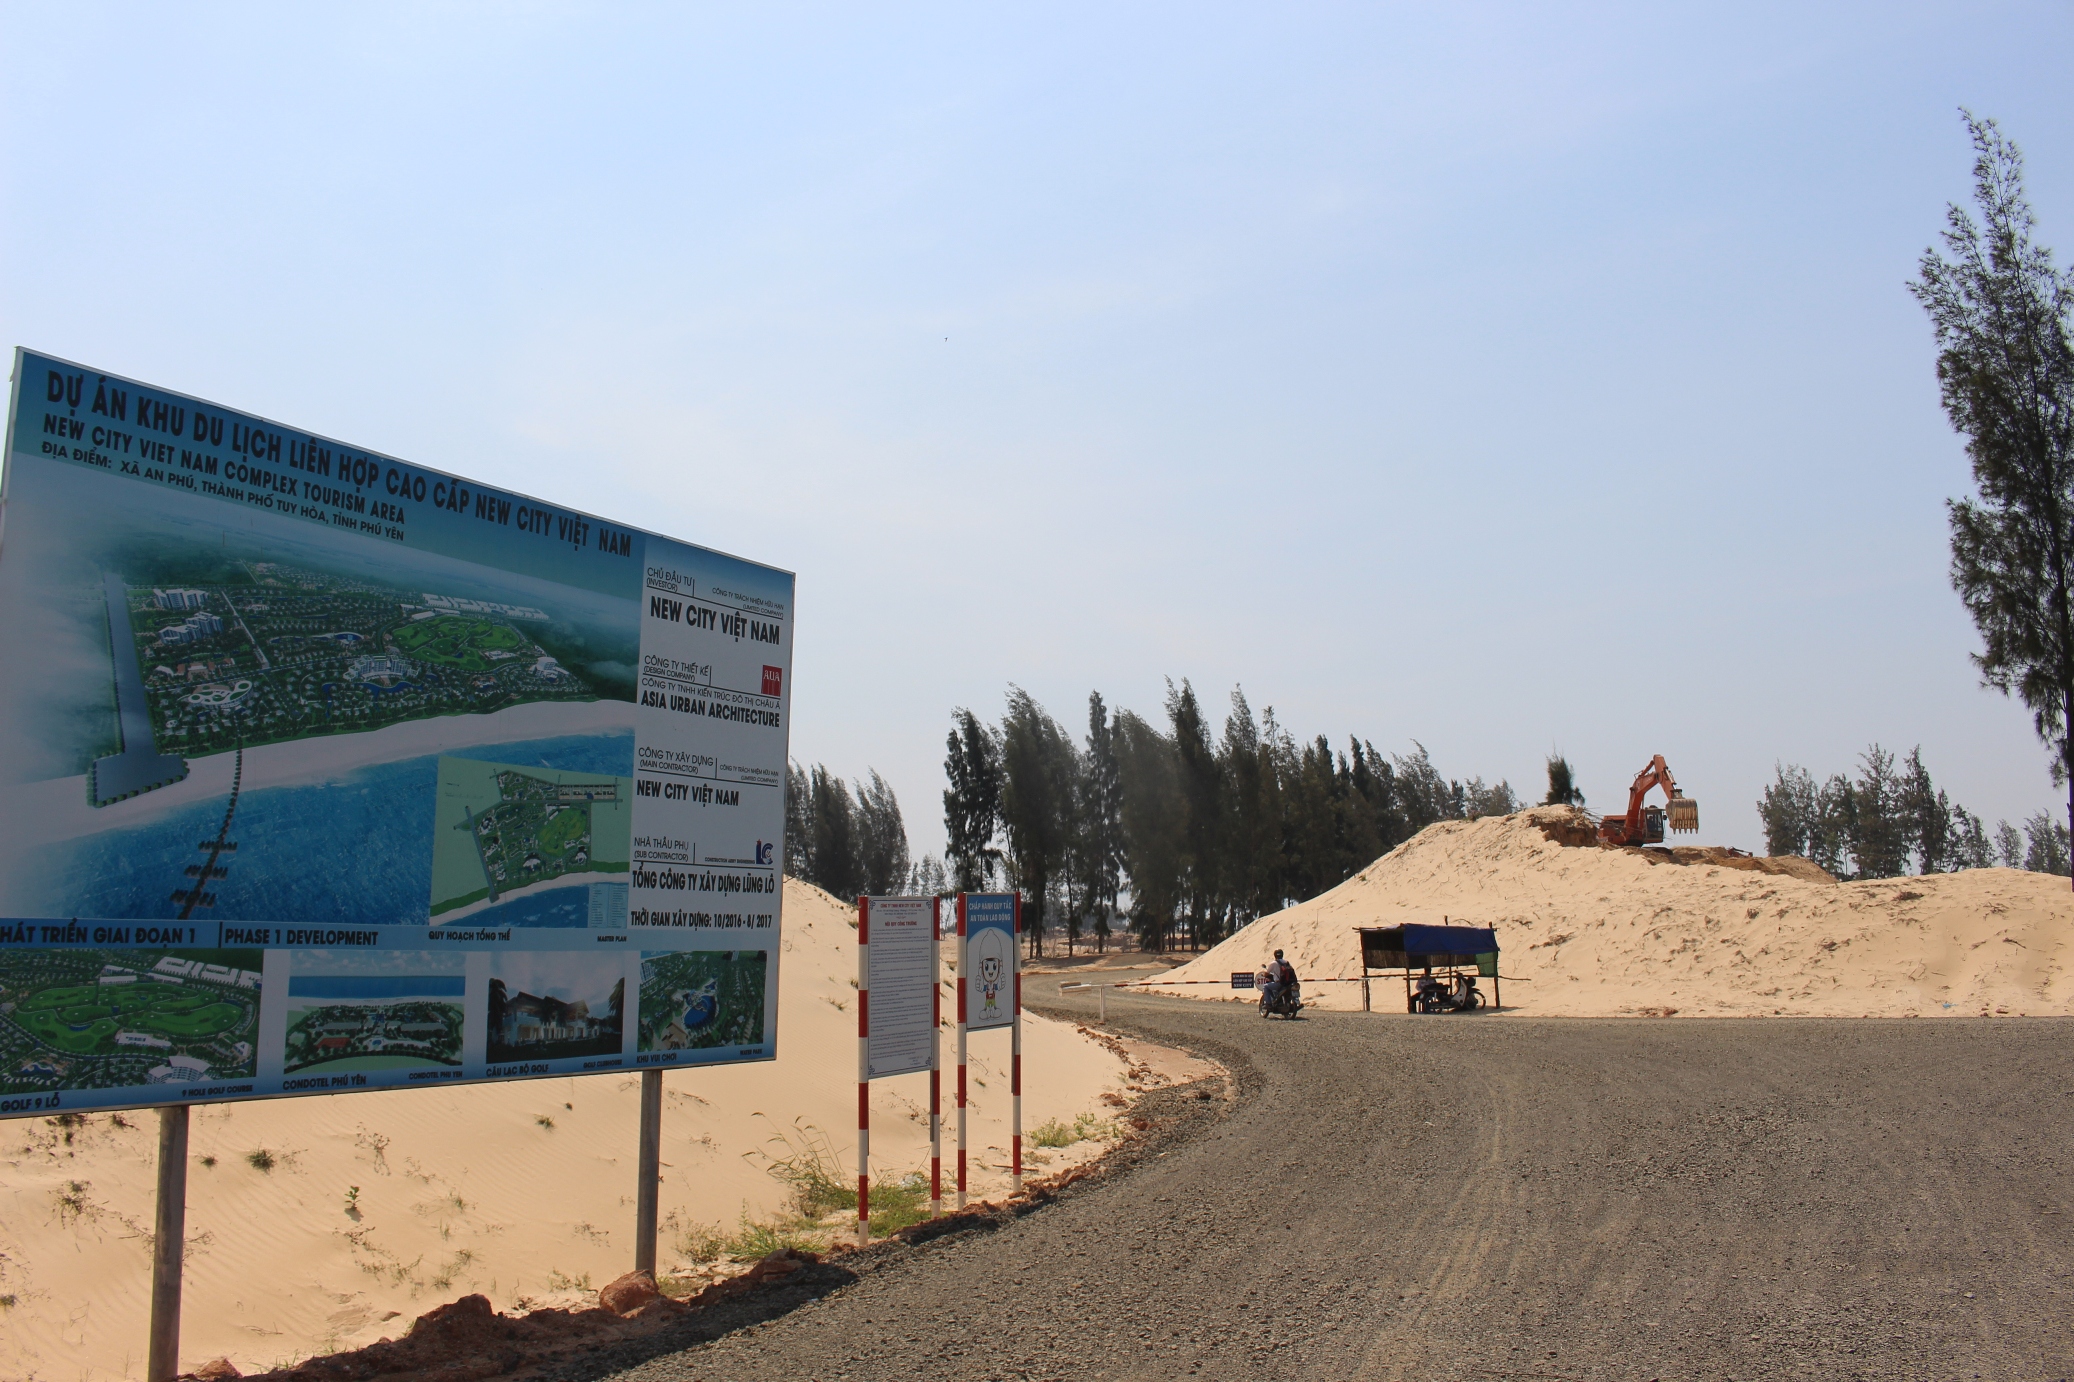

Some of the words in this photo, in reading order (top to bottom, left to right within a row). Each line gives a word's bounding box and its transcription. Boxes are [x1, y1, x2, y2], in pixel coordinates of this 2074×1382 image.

[43, 413, 85, 441] NEW
[92, 426, 132, 453] CITY
[139, 438, 175, 465] VIET
[181, 449, 218, 475] NAM
[224, 461, 298, 496] COMPLEX
[303, 482, 365, 514] TOURISM
[370, 500, 405, 524] AREA
[47, 370, 84, 417] DỰ
[91, 375, 127, 421] ÁN
[137, 396, 184, 437] KHU
[193, 412, 223, 446] DU
[232, 423, 281, 463] LỊCH
[290, 437, 330, 477] LIÊN
[339, 454, 379, 493] HỢP
[386, 467, 426, 502] CAO
[433, 479, 469, 514] CẤP
[475, 494, 511, 525] NEW
[517, 506, 552, 536] CITY
[559, 514, 589, 551] VIỆT
[599, 528, 631, 558] NAM
[42, 441, 67, 459] ĐỊA
[73, 447, 112, 469] ĐIỂM:
[120, 460, 140, 476] XÃ
[144, 467, 164, 481] AN
[168, 474, 198, 492] PHÚ,
[202, 481, 244, 500] THÀNH
[247, 492, 273, 509] PHỐ
[277, 499, 297, 514] TUY
[300, 506, 329, 525] HÒA,
[333, 512, 357, 529] TỈNH
[360, 522, 382, 535] PHÚ
[385, 526, 404, 541] YÊN
[647, 567, 664, 579] CHỦ
[665, 570, 682, 584] ĐẦU
[683, 576, 693, 586] TƯ
[647, 577, 678, 593] (INVESTOR)
[650, 595, 682, 623] NEW
[686, 604, 717, 631] CITY
[720, 611, 747, 642] VIỆT
[751, 620, 780, 645] NAM
[643, 666, 666, 676] (DESIGN
[666, 670, 696, 682] COMPANY)
[644, 655, 669, 668] CÔNG
[671, 660, 680, 671] TY
[681, 662, 699, 675] THIẾT
[700, 664, 709, 677] KẾ
[641, 678, 666, 689] CÔNG
[668, 681, 677, 690] TY
[677, 684, 696, 695] TNHH
[697, 687, 712, 698] KIẾN
[713, 690, 731, 701] TRÚC
[755, 698, 774, 709] CHÂU
[641, 690, 667, 709] ASIA
[670, 694, 706, 717] URBAN
[708, 702, 780, 728] ARCHITECTURE
[638, 746, 663, 759] CÔNG
[665, 749, 675, 760] TY
[675, 751, 691, 763] XÂY
[692, 754, 714, 767] DỰNG
[640, 759, 658, 769] (MAIN
[658, 762, 699, 775] CONTRACTOR)
[637, 779, 661, 798] NEW
[664, 783, 689, 801] CITY
[692, 783, 713, 807] VIỆT
[715, 789, 739, 806] NAM
[634, 836, 651, 848] NHÀ
[652, 836, 673, 850] THẦU
[674, 840, 689, 851] PHỤ
[634, 850, 647, 860] (SUB
[648, 851, 689, 862] CONTRACTOR)
[632, 862, 657, 889] TỔNG
[659, 868, 686, 890] CÔNG
[688, 873, 698, 891] TY
[699, 870, 716, 892] XÂY
[718, 873, 741, 897] DỰNG
[765, 873, 775, 894] LÔ
[631, 907, 649, 926] THỜI
[651, 911, 670, 927] GIAN
[672, 908, 687, 927] XÂY
[689, 911, 712, 931] DỰNG:
[714, 913, 742, 929] 10/2016
[756, 914, 772, 928] 2017
[41, 917, 88, 944] TRIỂN
[93, 927, 130, 944] GIAI
[135, 927, 183, 948] ĐOẠN
[189, 927, 195, 944] 1
[225, 929, 270, 944] PHASE
[274, 930, 282, 944] 1
[287, 929, 379, 946] DEVELOPMENT
[428, 930, 444, 941] QUY
[446, 931, 474, 942] HOẠCH
[636, 1055, 649, 1064] KHU
[651, 1054, 660, 1062] VUI
[409, 1072, 439, 1080] CONDOTEL
[486, 1065, 501, 1077] CÂU
[504, 1066, 518, 1078] LẠC
[519, 1063, 529, 1076] BỘ
[531, 1064, 549, 1074] GOLF
[182, 1089, 187, 1097] 9
[188, 1088, 206, 1097] HOLE
[208, 1087, 225, 1096] GOLF
[227, 1085, 253, 1094] COURSE
[283, 1078, 329, 1090] CONDOTEL
[331, 1074, 348, 1087] PHÚ
[351, 1075, 366, 1086] YÊN
[1, 1098, 32, 1112] GOLF
[35, 1097, 41, 1109] 9
